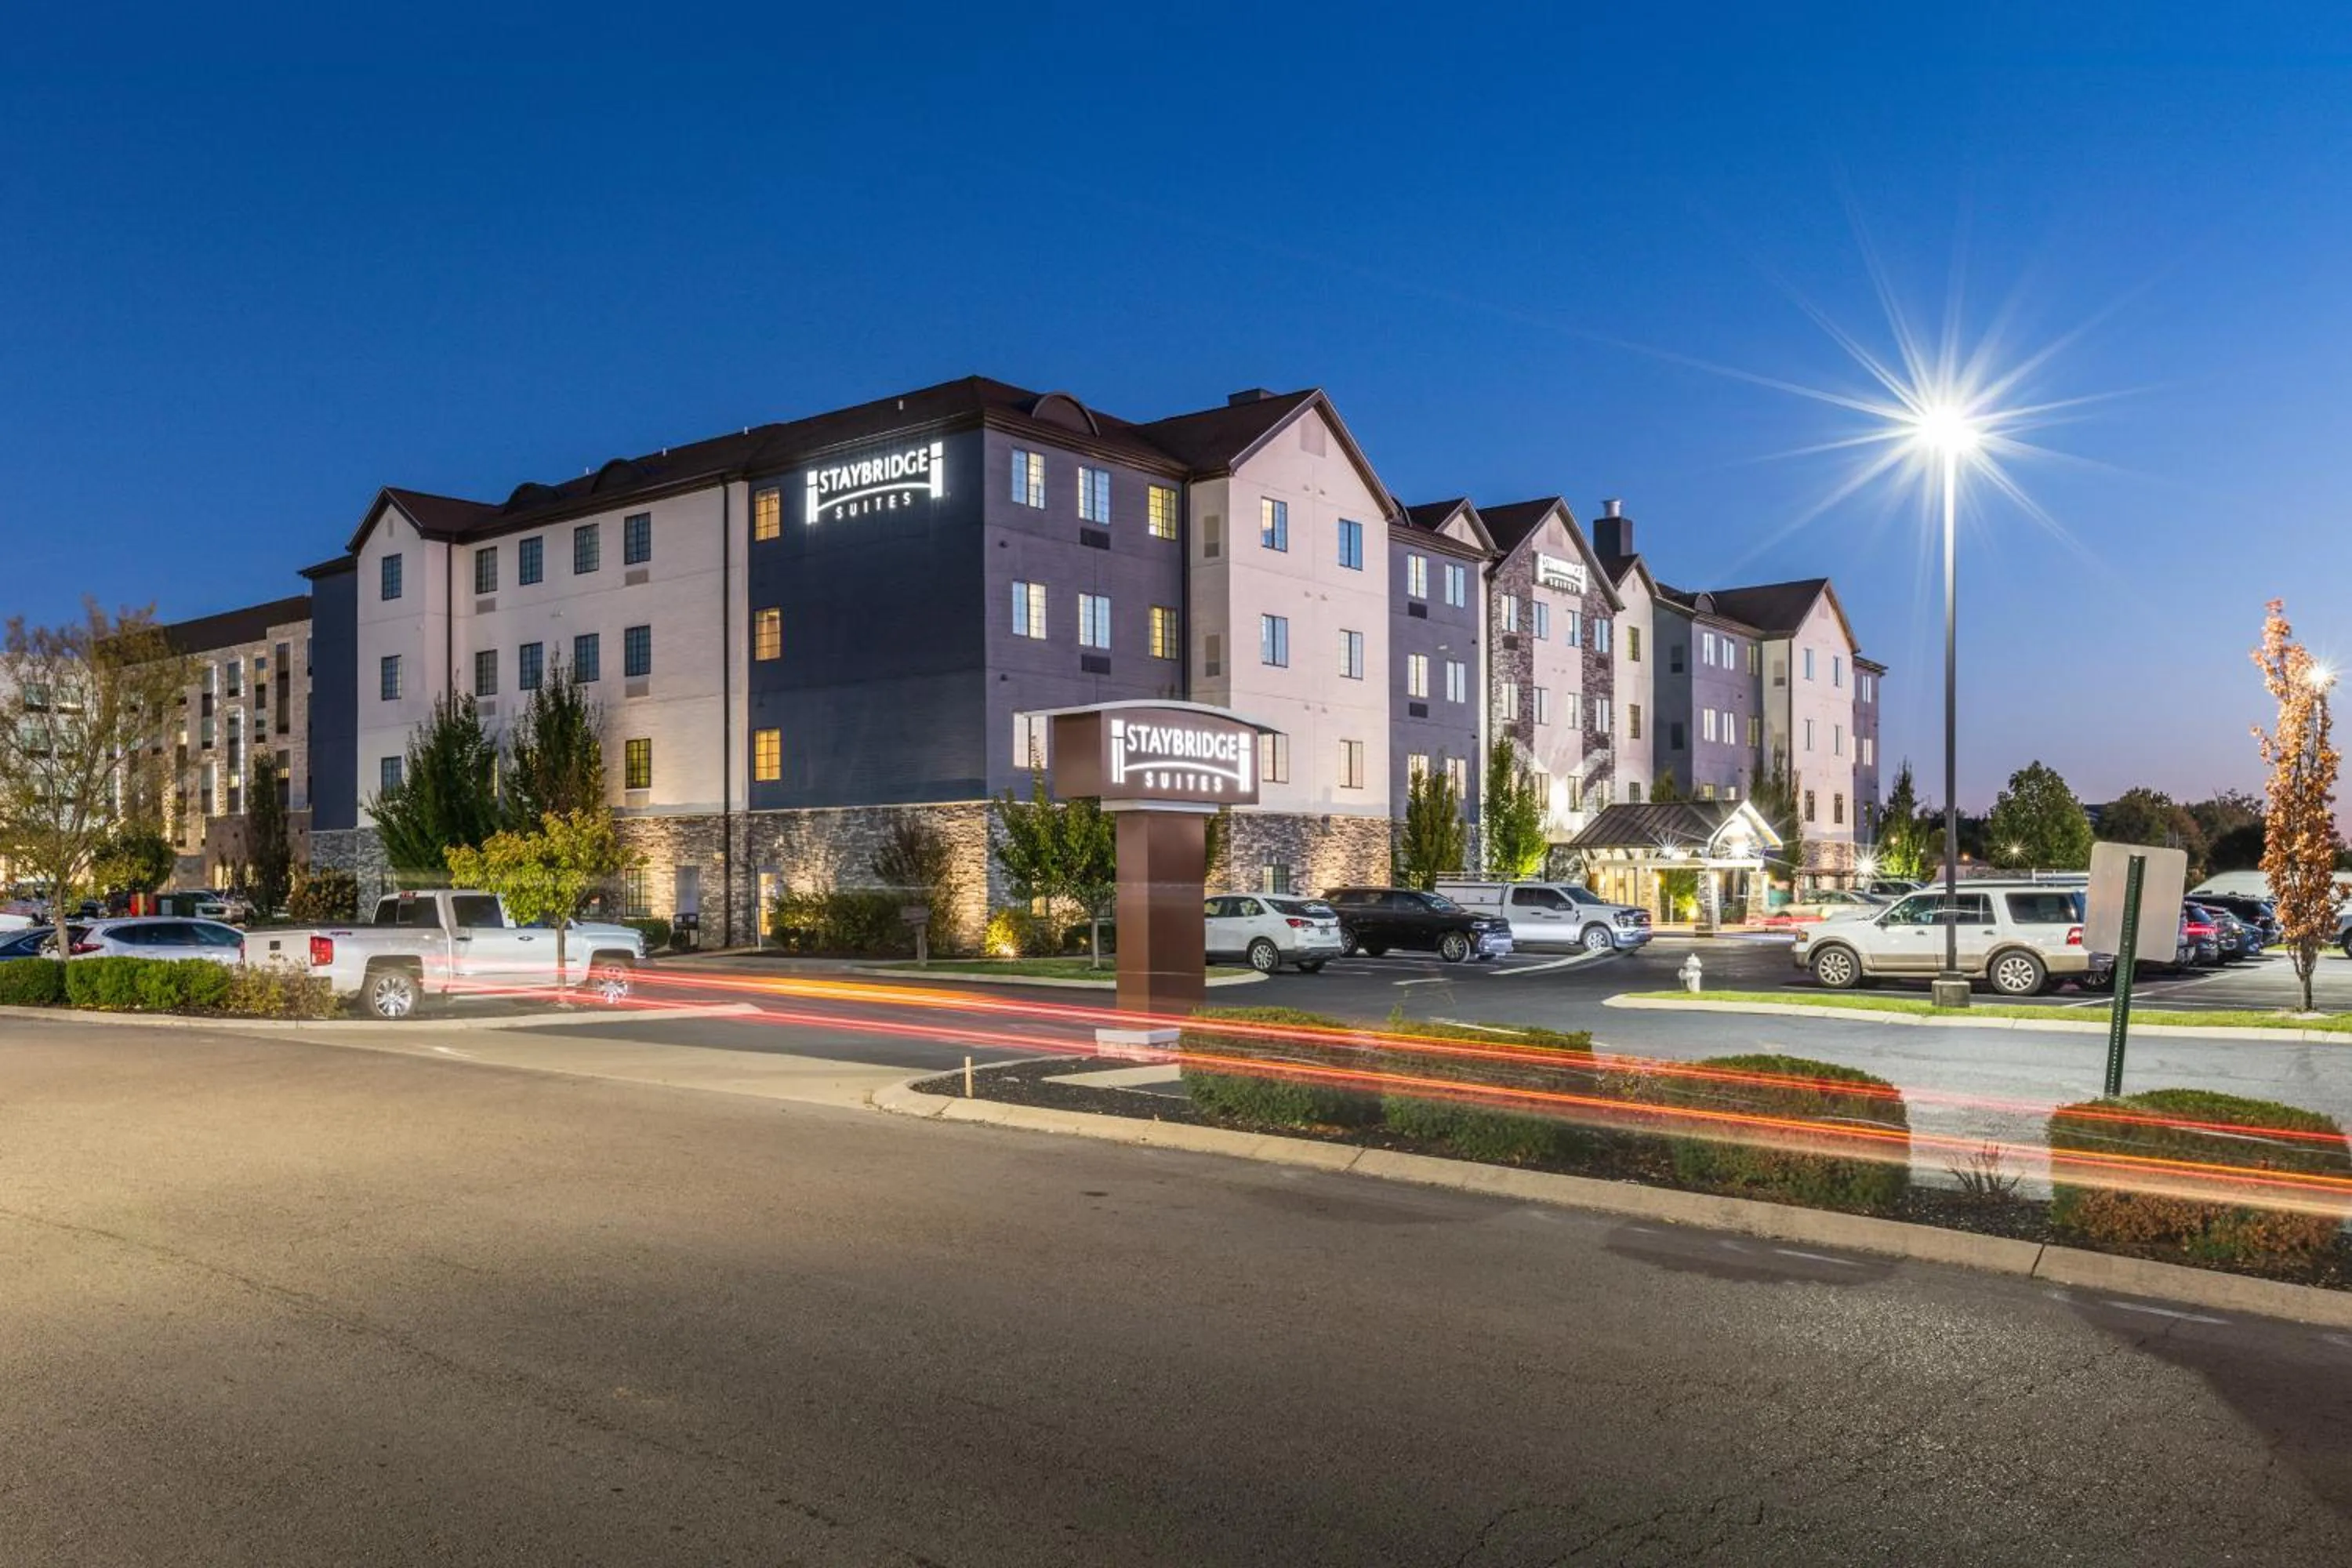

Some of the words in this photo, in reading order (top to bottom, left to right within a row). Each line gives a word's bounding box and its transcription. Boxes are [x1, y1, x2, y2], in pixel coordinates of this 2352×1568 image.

[819, 448, 928, 493] STAYBRIDGE
[836, 492, 911, 520] SUITES
[1127, 724, 1237, 760] STAYBRIDGE
[1145, 771, 1223, 793] SUITES
